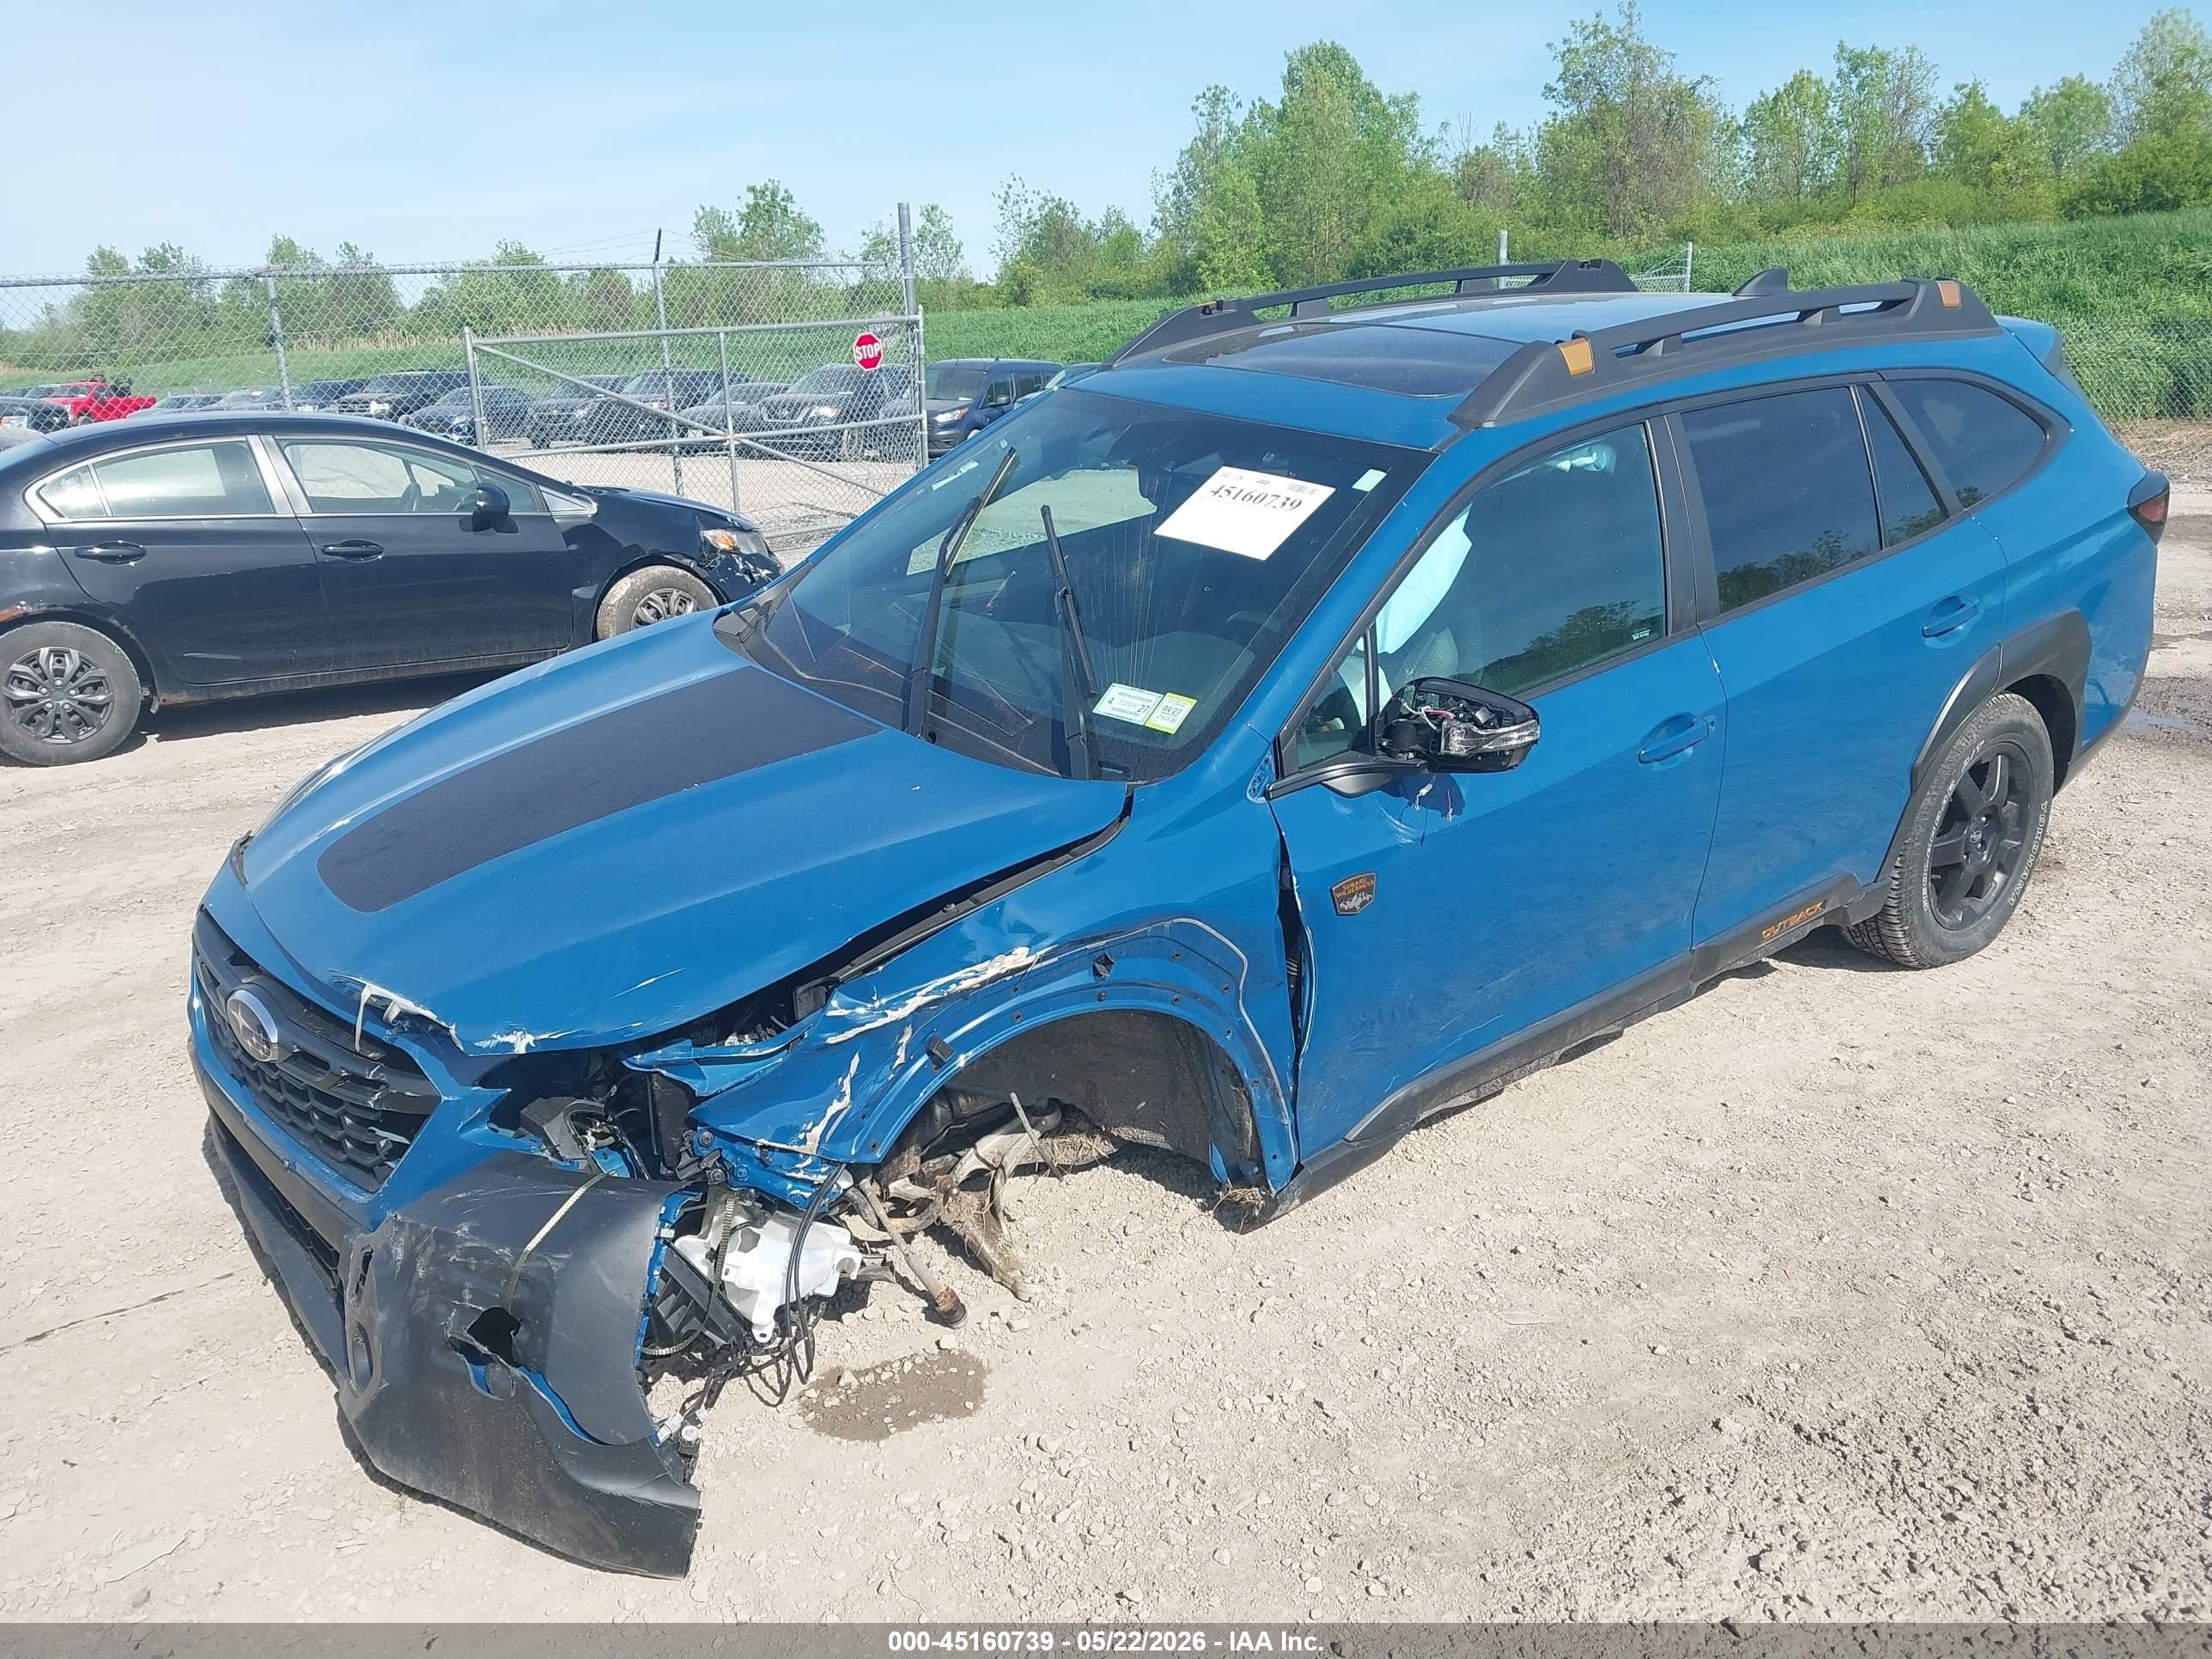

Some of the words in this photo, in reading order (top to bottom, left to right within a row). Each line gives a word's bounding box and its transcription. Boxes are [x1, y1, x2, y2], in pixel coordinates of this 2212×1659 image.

[856, 343, 880, 361] STOP
[1210, 484, 1303, 511] 45160739
[2008, 799, 2048, 907] YOKOHAMA
[1335, 879, 1375, 898] WILDERNESS
[1342, 876, 1368, 890] SUBARU
[1760, 899, 1827, 939] OUTBACK
